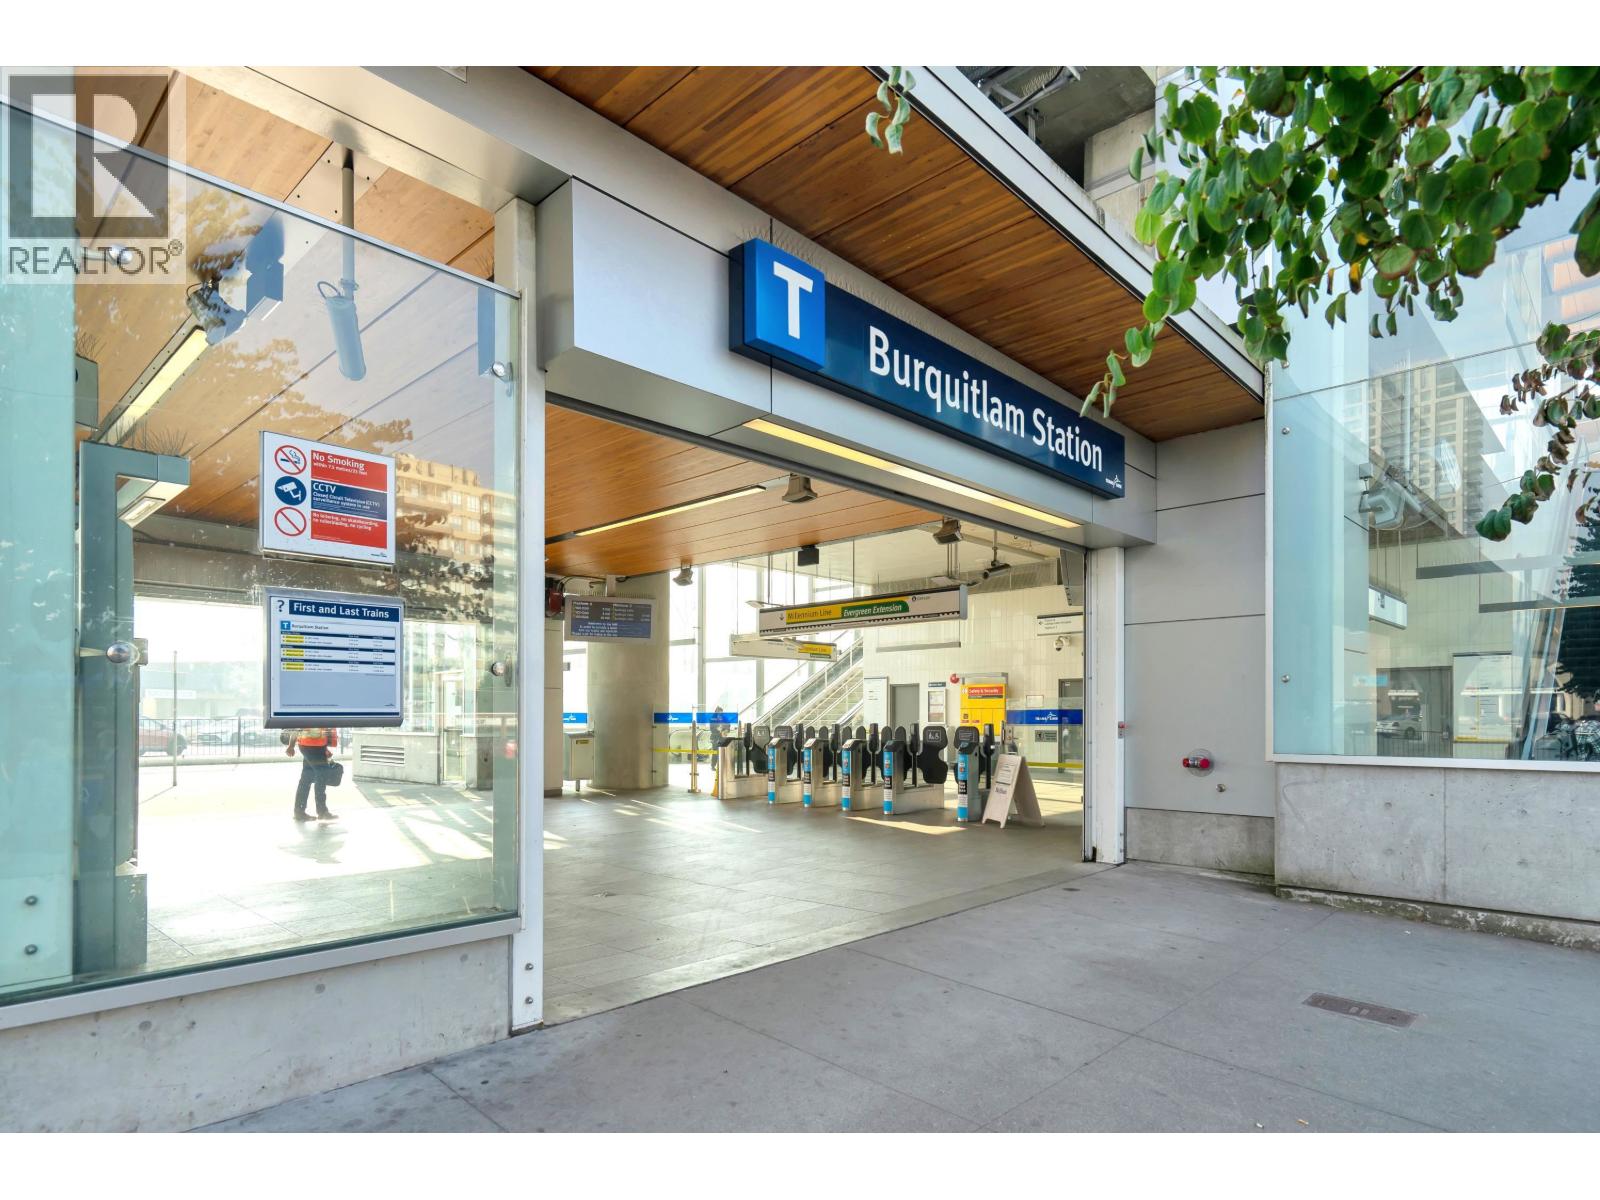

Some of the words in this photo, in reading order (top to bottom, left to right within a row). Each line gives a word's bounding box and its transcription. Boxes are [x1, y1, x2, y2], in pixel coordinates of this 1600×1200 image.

[772, 260, 814, 340] T
[868, 325, 1025, 439] Burquitlam
[1032, 408, 1102, 473] Station
[312, 452, 325, 462] No
[327, 455, 365, 471] Smoking
[312, 491, 329, 499] Closed
[313, 483, 337, 494] CCTV
[293, 602, 316, 613] First
[318, 605, 337, 615] and
[339, 605, 360, 617] Last
[362, 608, 390, 619] Trains
[787, 609, 819, 621] Millennium
[820, 609, 832, 617] Line
[843, 608, 872, 619] Evergreen
[873, 604, 902, 614] Extension
